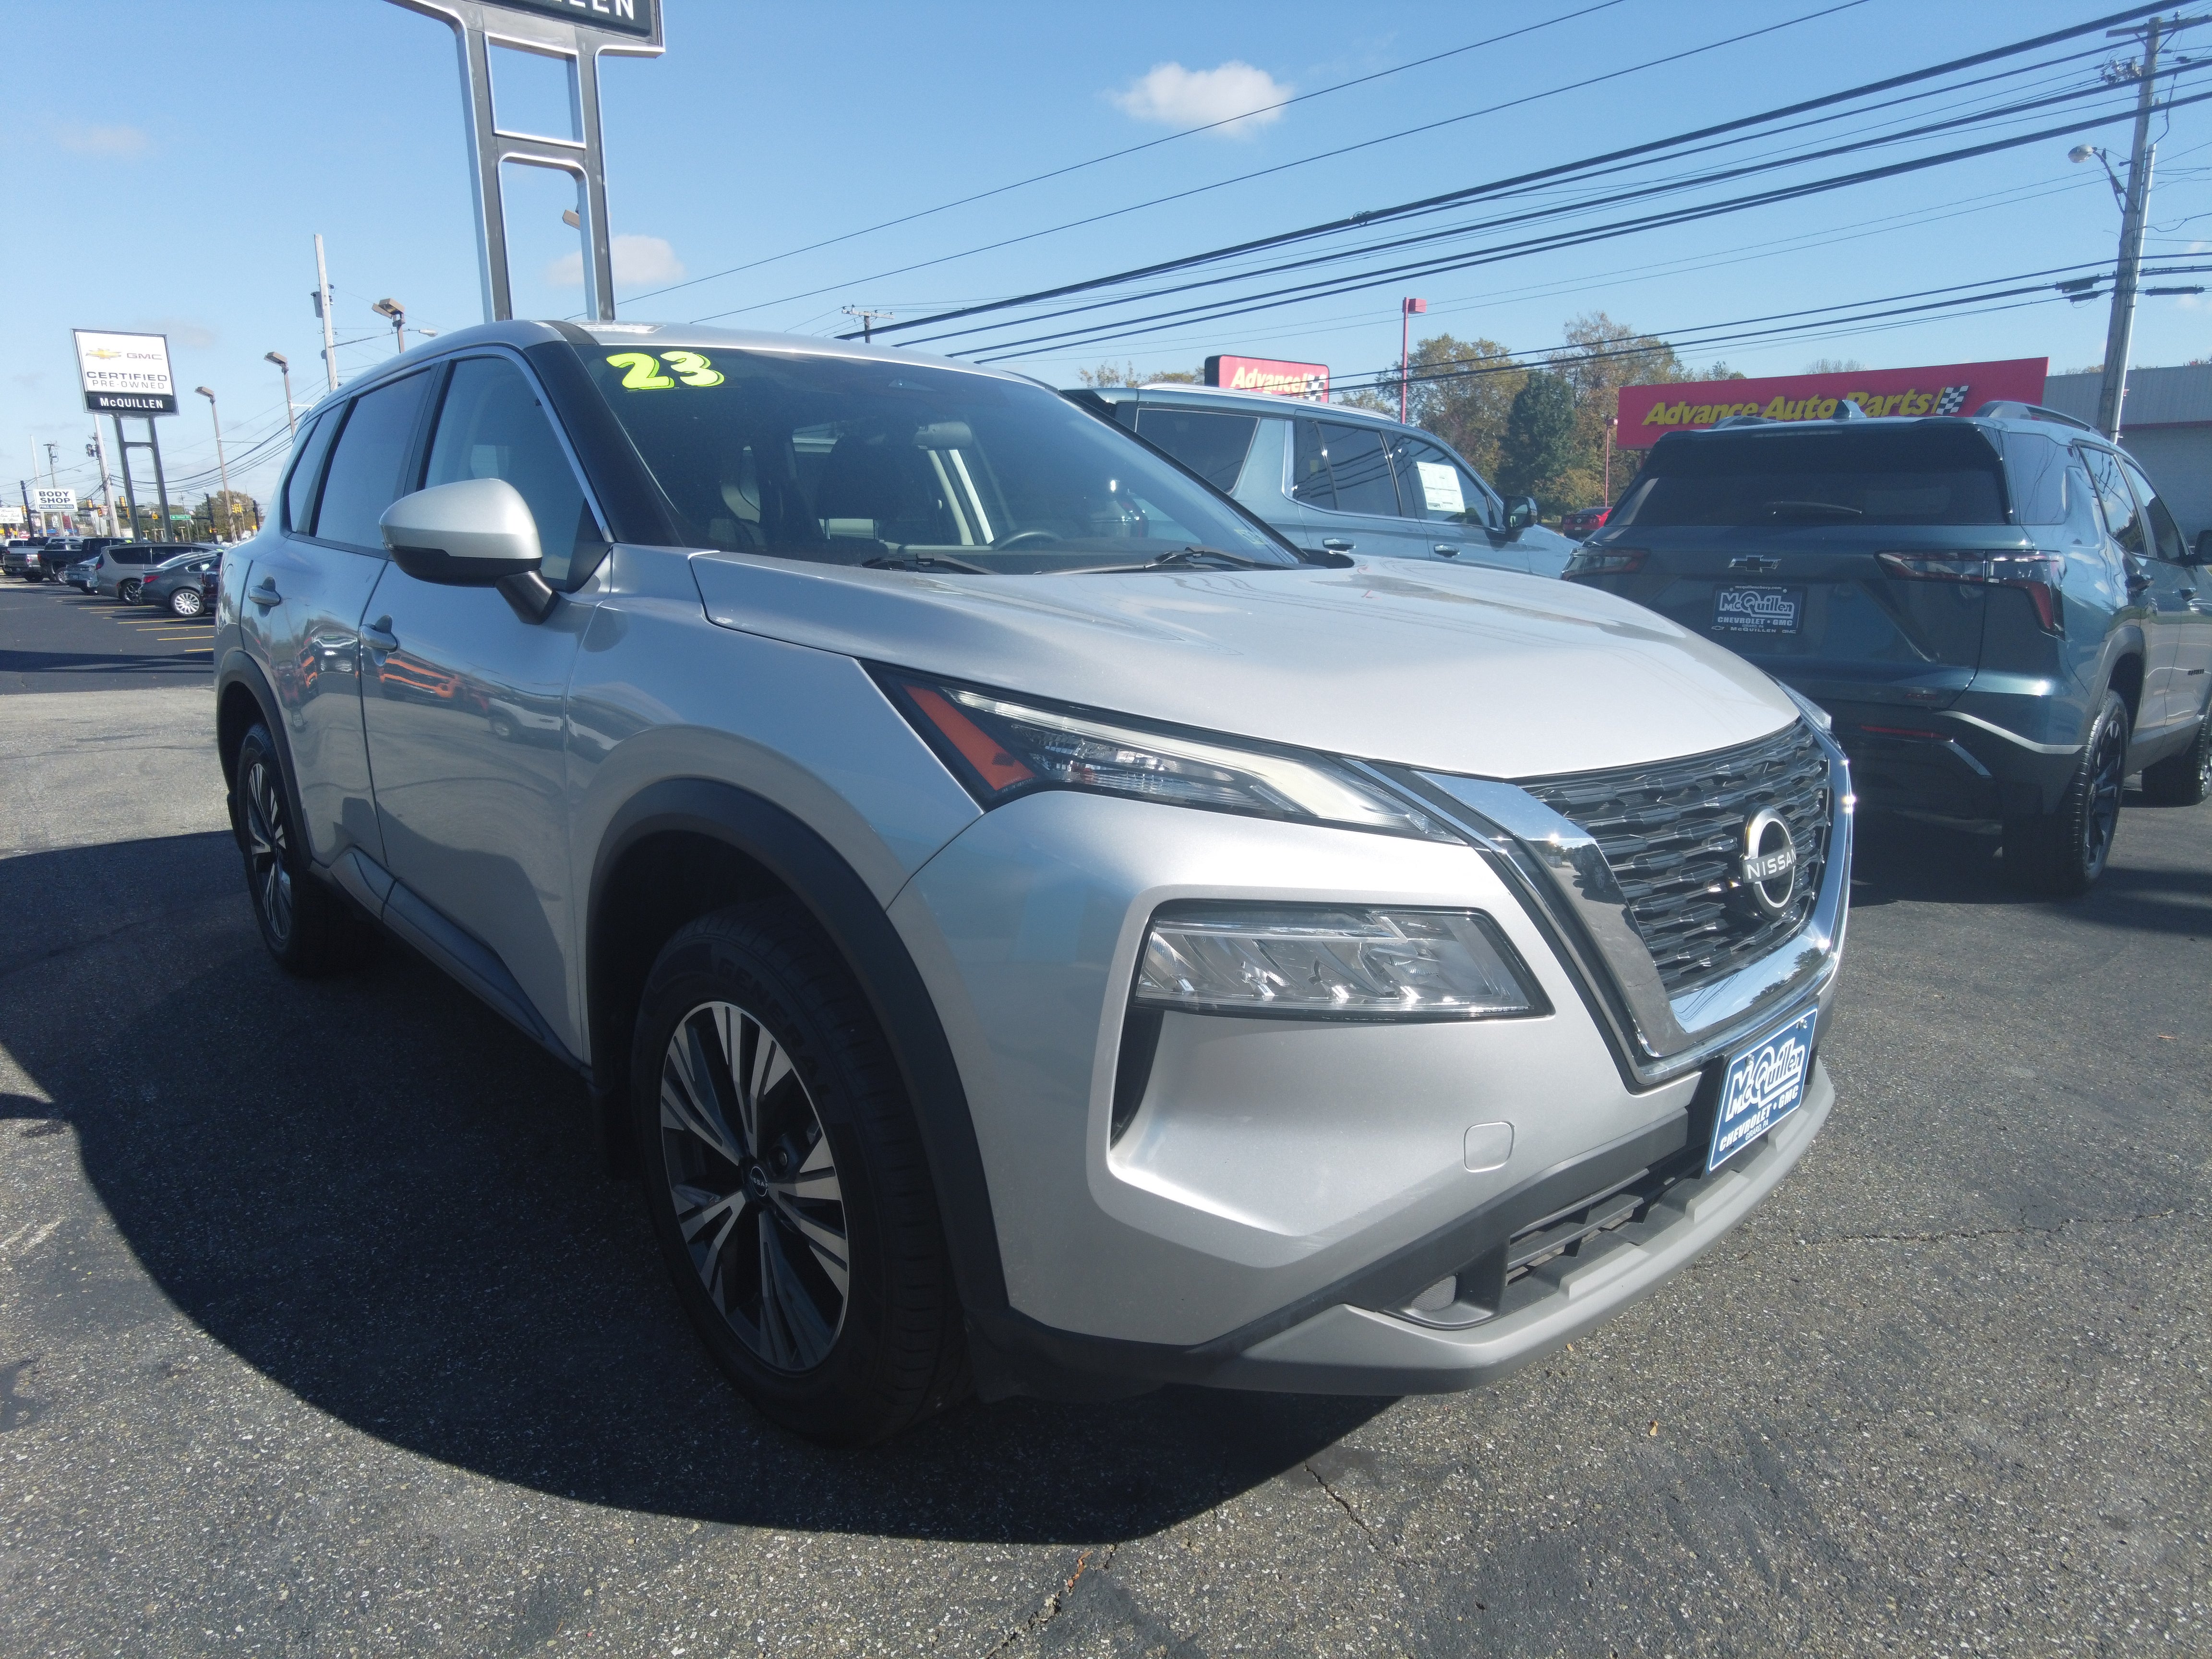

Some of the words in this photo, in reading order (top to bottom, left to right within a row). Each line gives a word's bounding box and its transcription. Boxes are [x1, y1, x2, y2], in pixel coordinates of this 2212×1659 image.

[86, 371, 168, 382] CERTIFIED
[606, 351, 725, 390] 23
[1229, 366, 1301, 393] Advance
[92, 380, 164, 389] PRE-OWNED
[99, 397, 163, 409] McQUILLEN
[1642, 401, 1759, 425] Advance
[1761, 394, 1838, 420] Auto
[1719, 591, 1794, 619] McQuillen
[1718, 616, 1765, 625] CHEVROLET
[1747, 846, 1796, 879] NISSAN
[1725, 1037, 1805, 1122] McQuillen
[1719, 1103, 1772, 1152] CHEVROLET
[1778, 1085, 1799, 1109] GMC
[1762, 1118, 1768, 1129] PA
